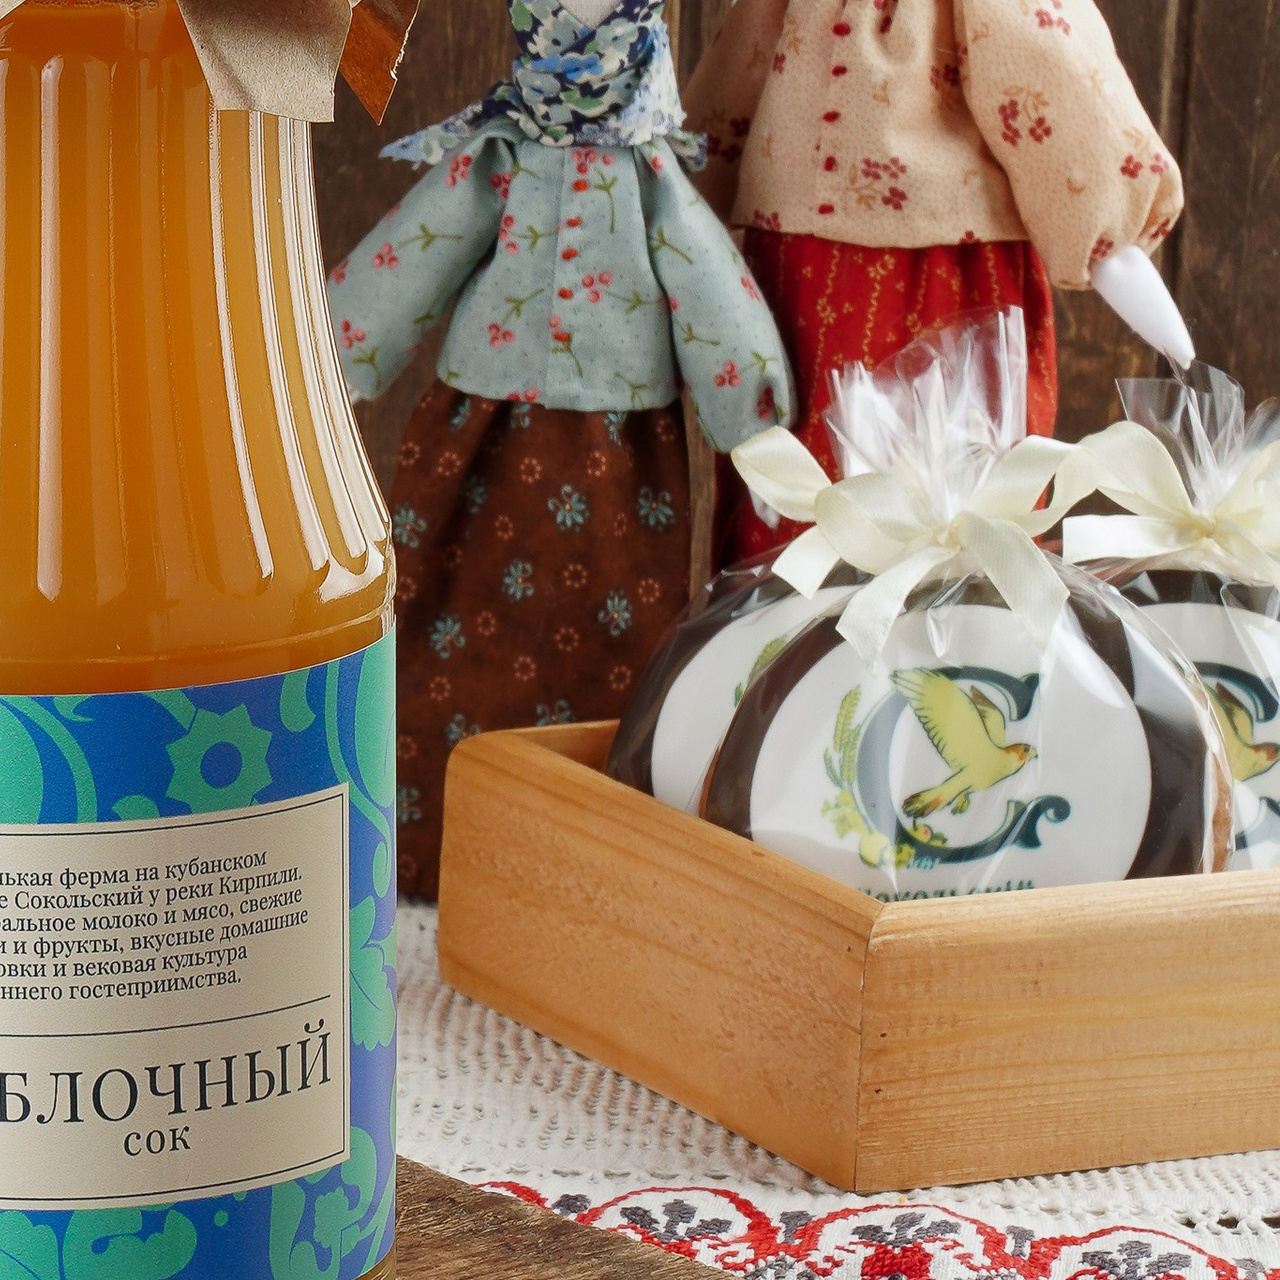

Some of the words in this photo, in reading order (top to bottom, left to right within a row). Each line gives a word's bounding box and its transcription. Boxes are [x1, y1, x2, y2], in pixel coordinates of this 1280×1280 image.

[15, 885, 144, 910] Сокольский
[149, 891, 160, 907] у
[166, 882, 214, 906] реки
[219, 866, 302, 895] Кирпили.
[59, 868, 130, 890] ферма
[136, 866, 159, 882] на
[165, 851, 268, 882] кубанском
[82, 912, 158, 931] молоко
[164, 910, 177, 925] и
[182, 903, 234, 922] мясо,
[239, 888, 302, 915] свежие
[13, 940, 27, 955] и
[33, 937, 124, 958] фрукты,
[130, 928, 215, 952] вкусные
[219, 909, 309, 942] домашние
[53, 962, 67, 977] и
[72, 957, 157, 977] вековая
[162, 945, 248, 972] культура
[68, 969, 242, 1000] гостеприимства.
[123, 1125, 193, 1157] сок
